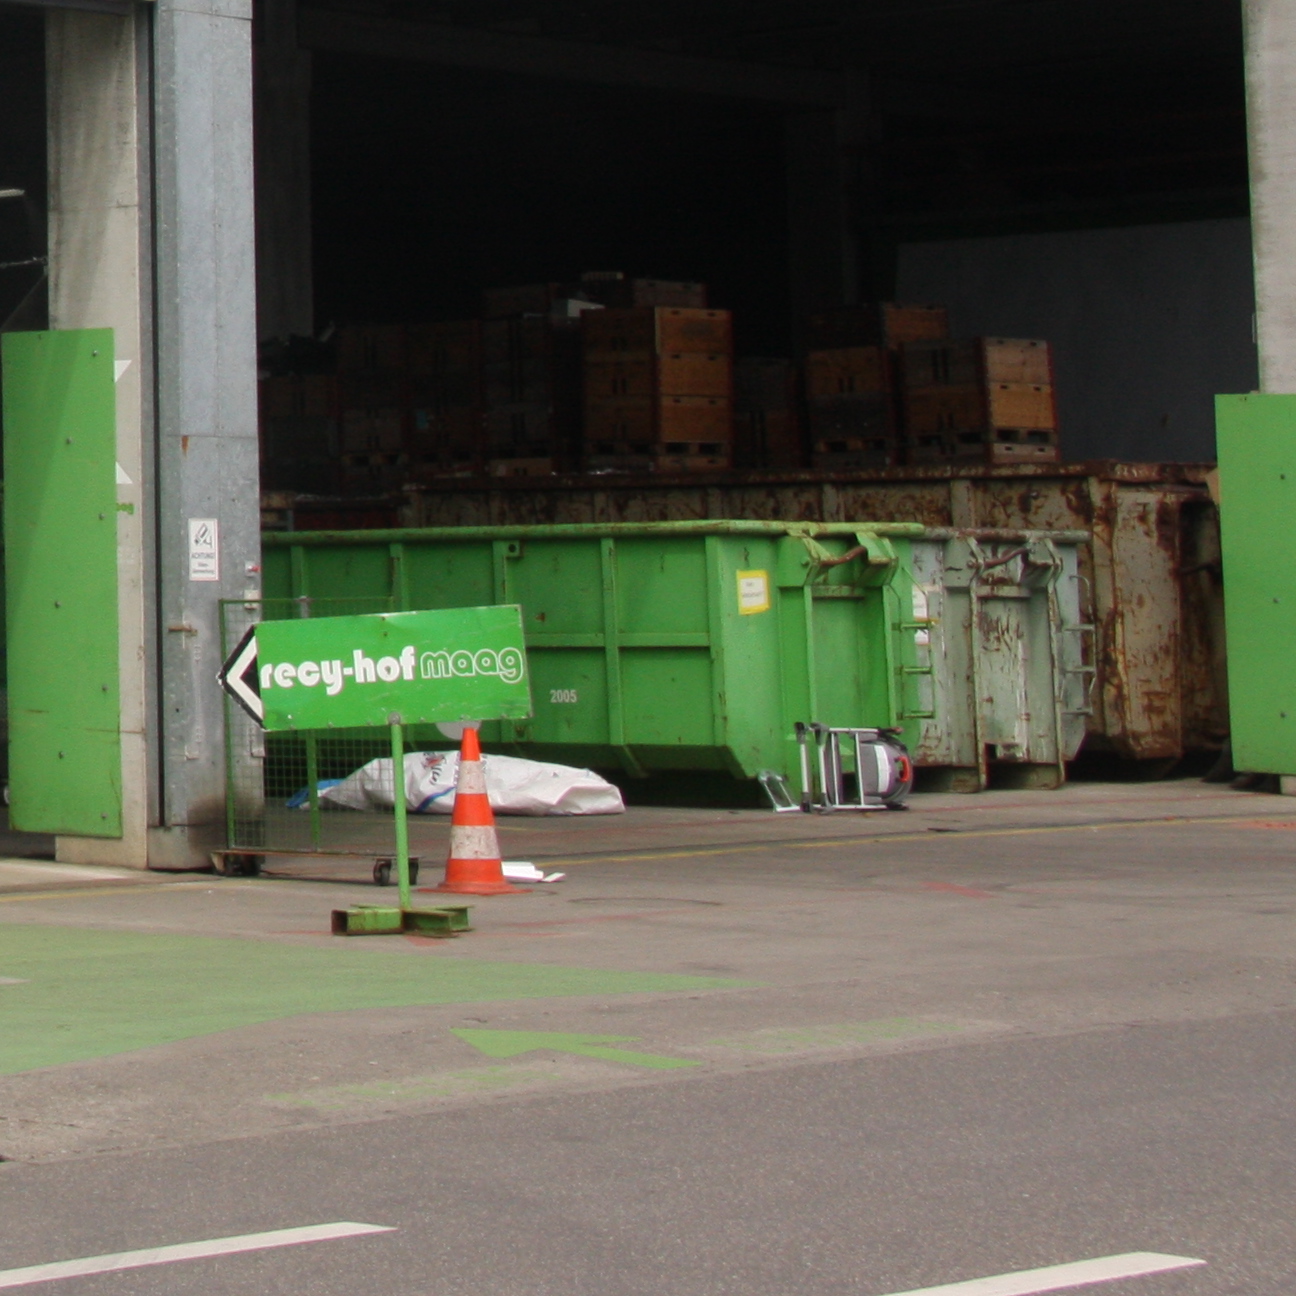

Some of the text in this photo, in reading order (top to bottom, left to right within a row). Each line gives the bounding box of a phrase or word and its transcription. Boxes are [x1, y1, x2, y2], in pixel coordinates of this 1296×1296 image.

[260, 645, 524, 697] recy-hof maag
[549, 689, 577, 704] 2005
